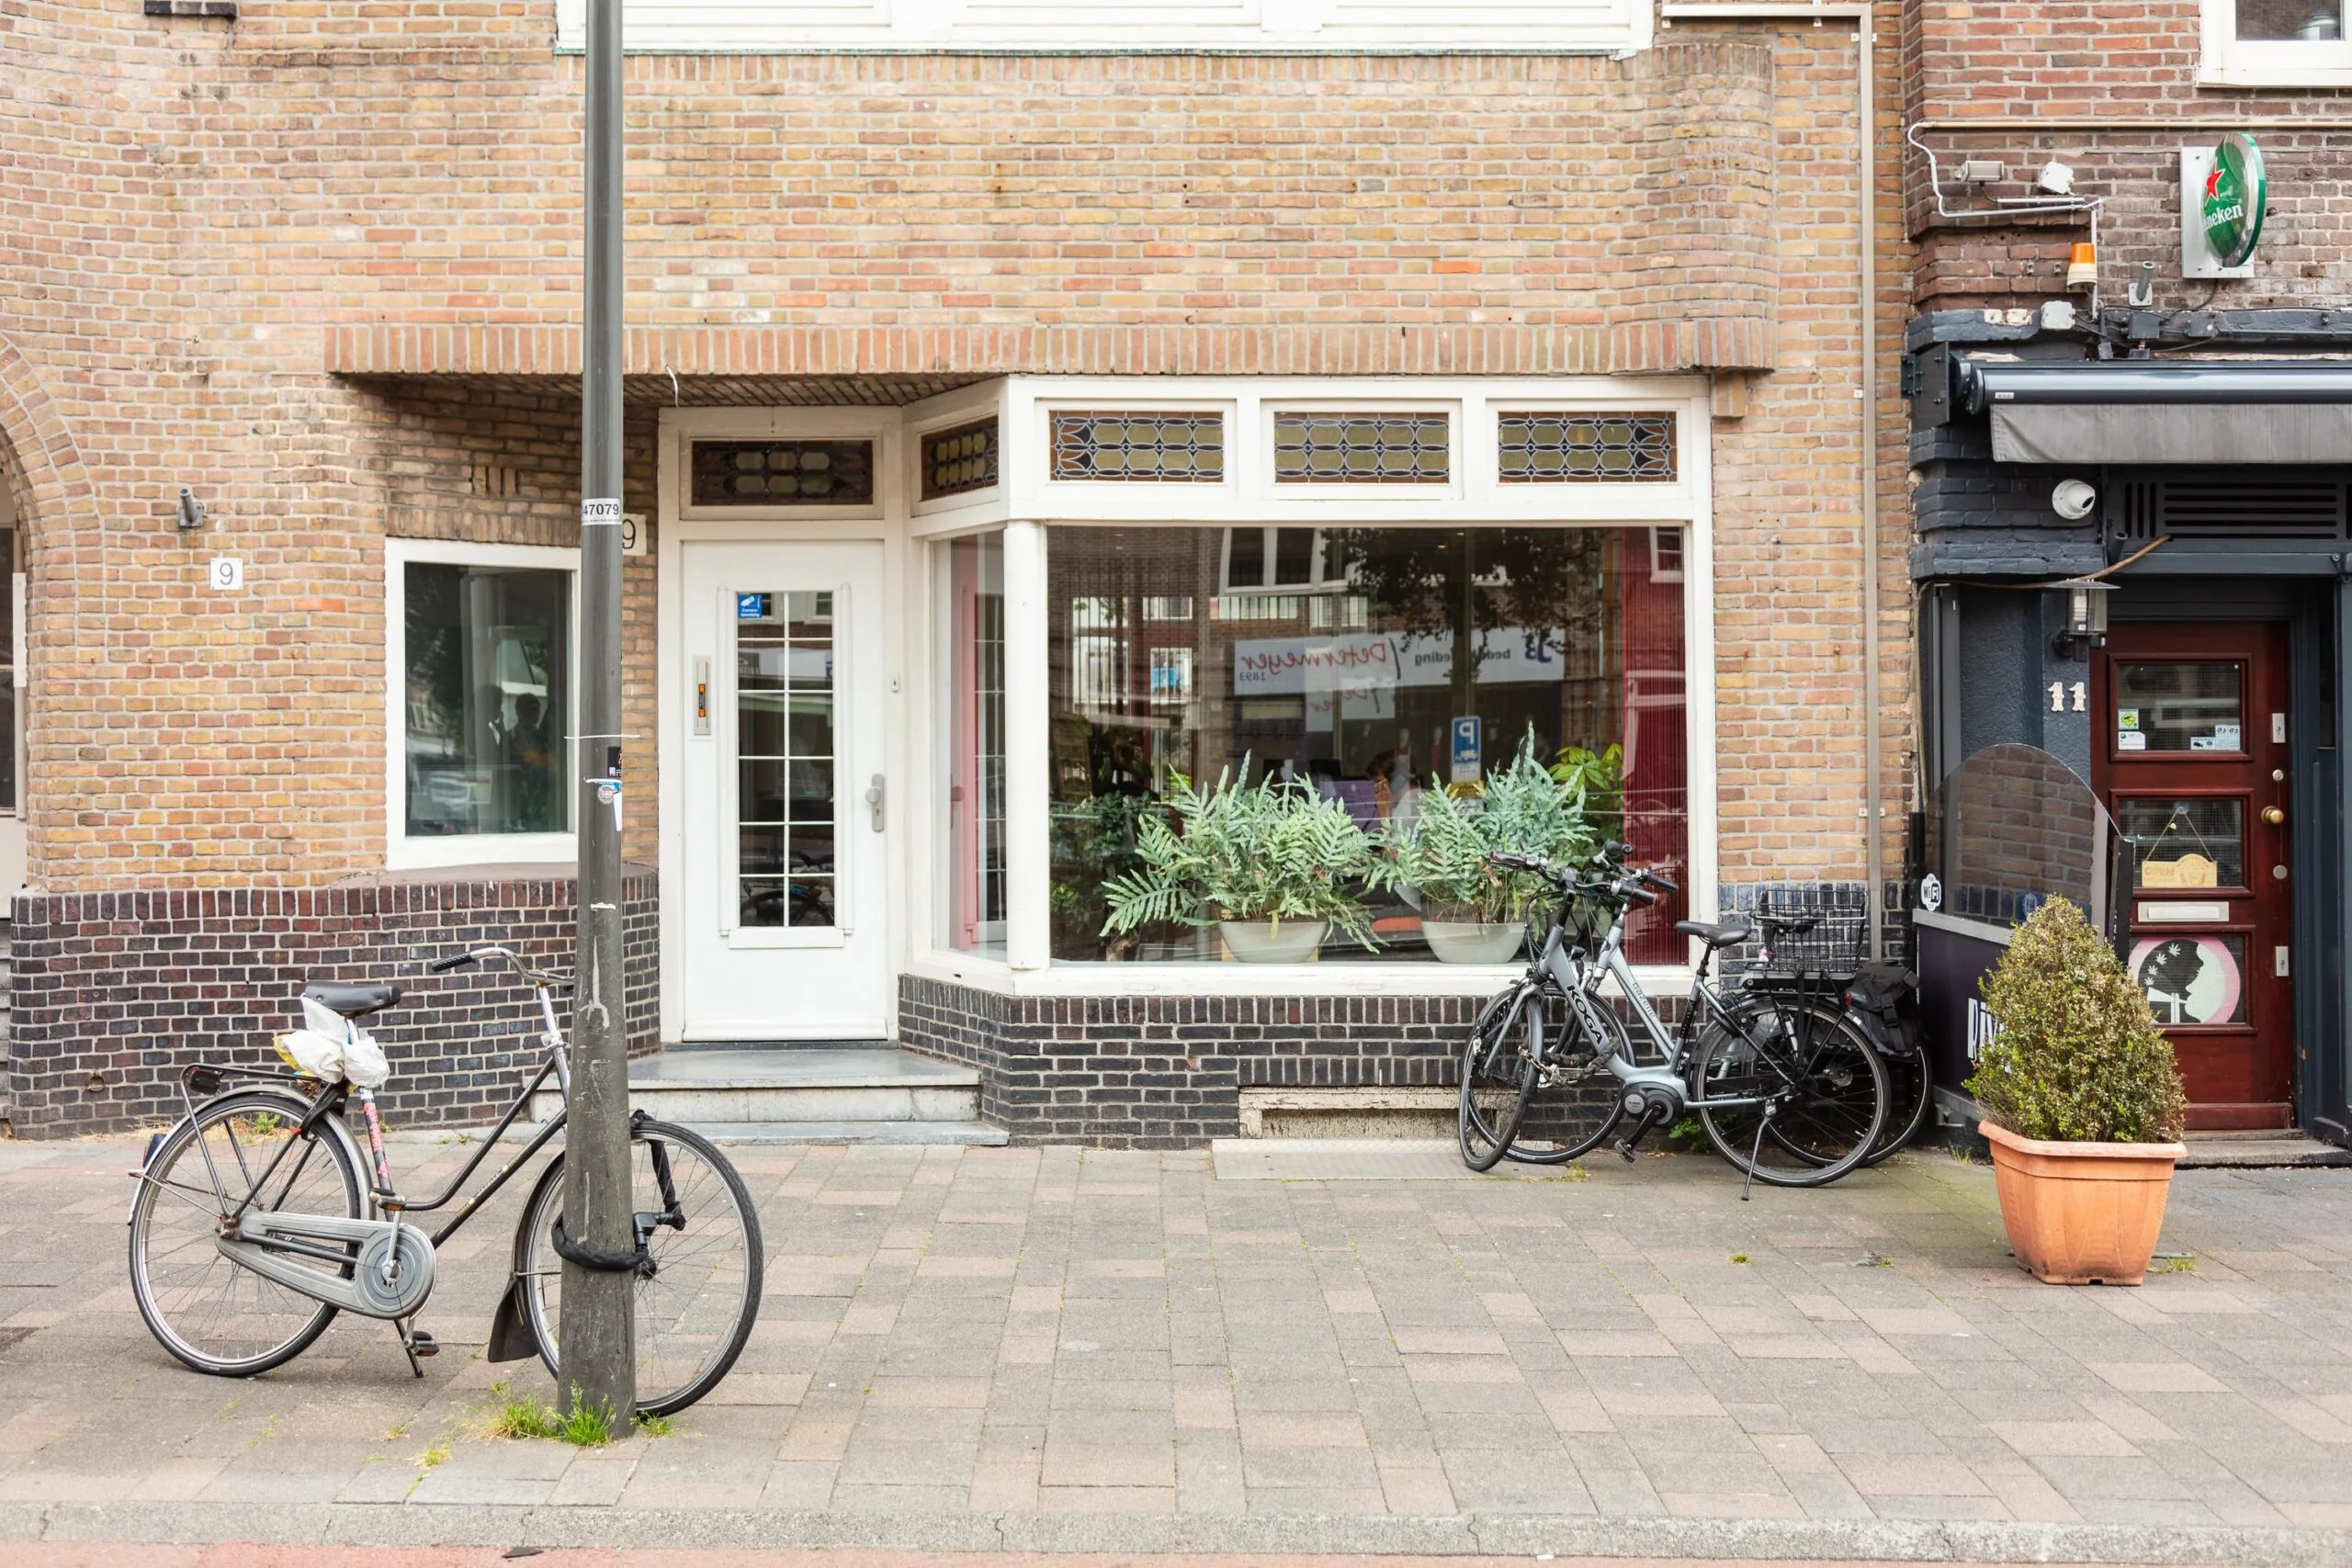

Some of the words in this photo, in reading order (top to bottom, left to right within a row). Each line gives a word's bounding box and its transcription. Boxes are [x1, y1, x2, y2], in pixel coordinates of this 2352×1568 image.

[582, 503, 619, 515] 47079
[622, 518, 637, 549] 9
[220, 562, 233, 586] 9
[2047, 682, 2086, 712] 11
[1566, 985, 1603, 1045] KOGA
